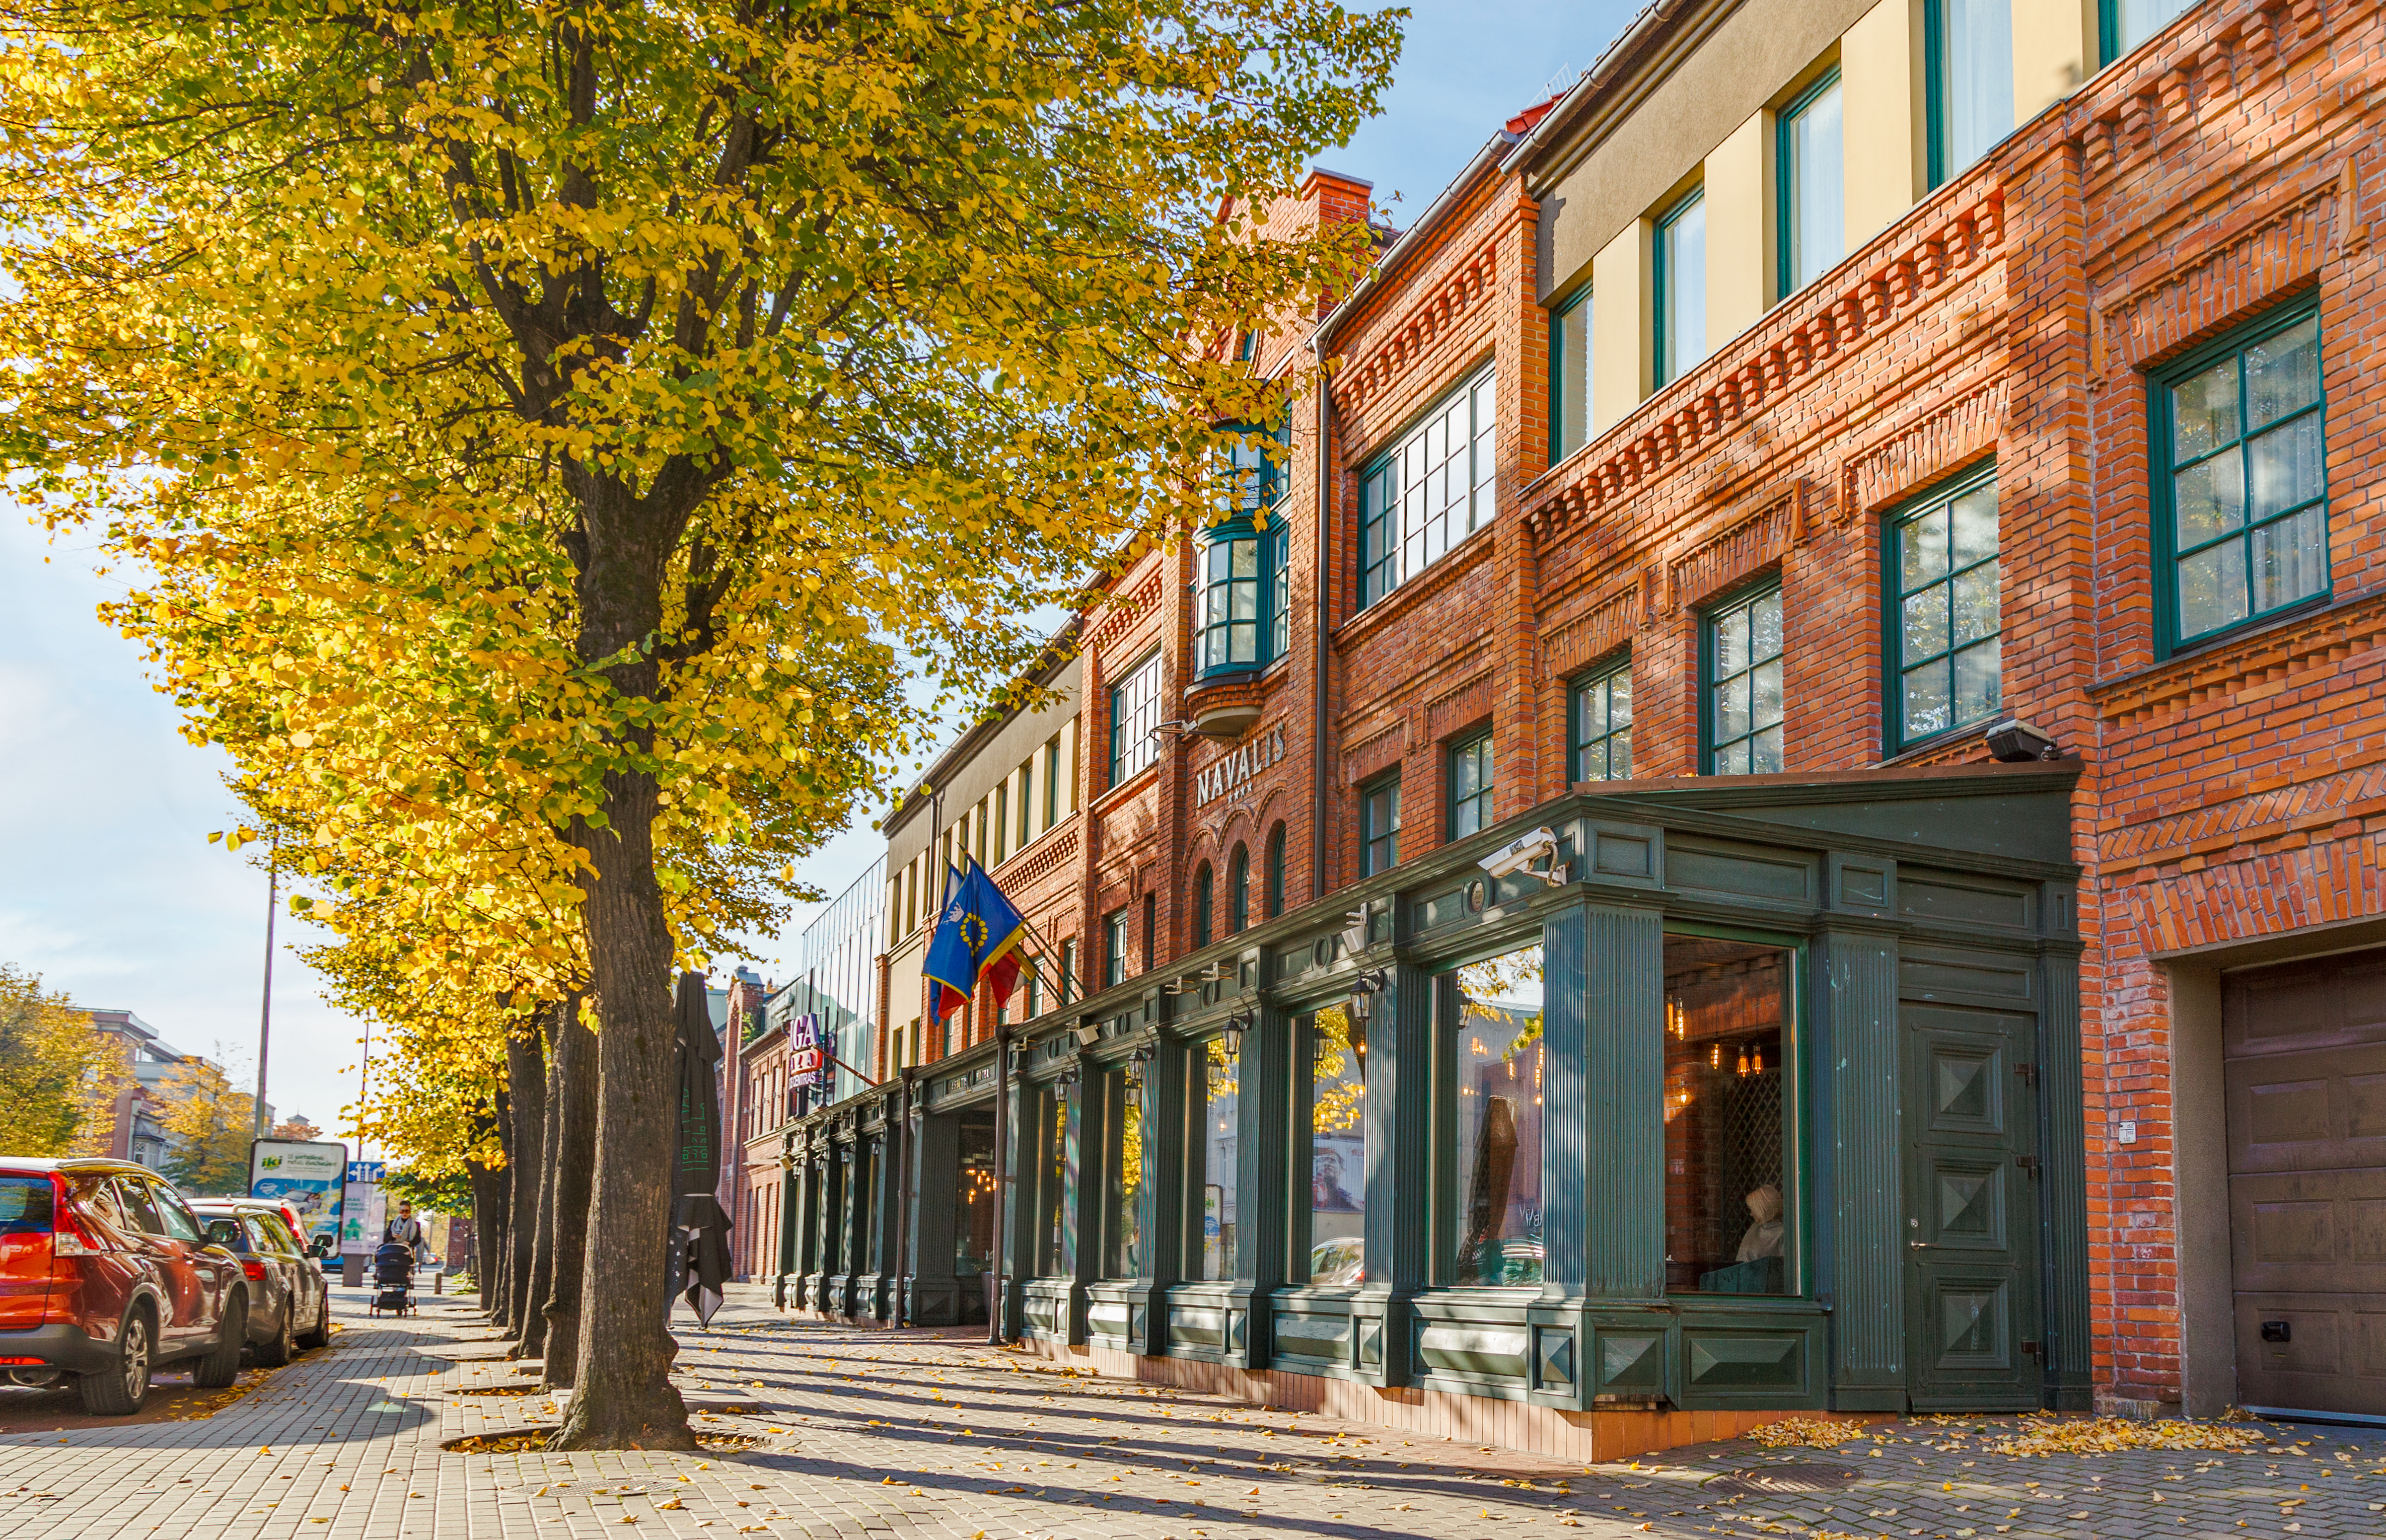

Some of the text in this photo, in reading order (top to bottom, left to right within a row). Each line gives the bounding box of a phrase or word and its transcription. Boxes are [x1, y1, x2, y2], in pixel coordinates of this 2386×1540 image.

[1196, 722, 1284, 809] NAVALIS
[793, 1071, 817, 1088] CENTRAS
[261, 1155, 283, 1167] iki
